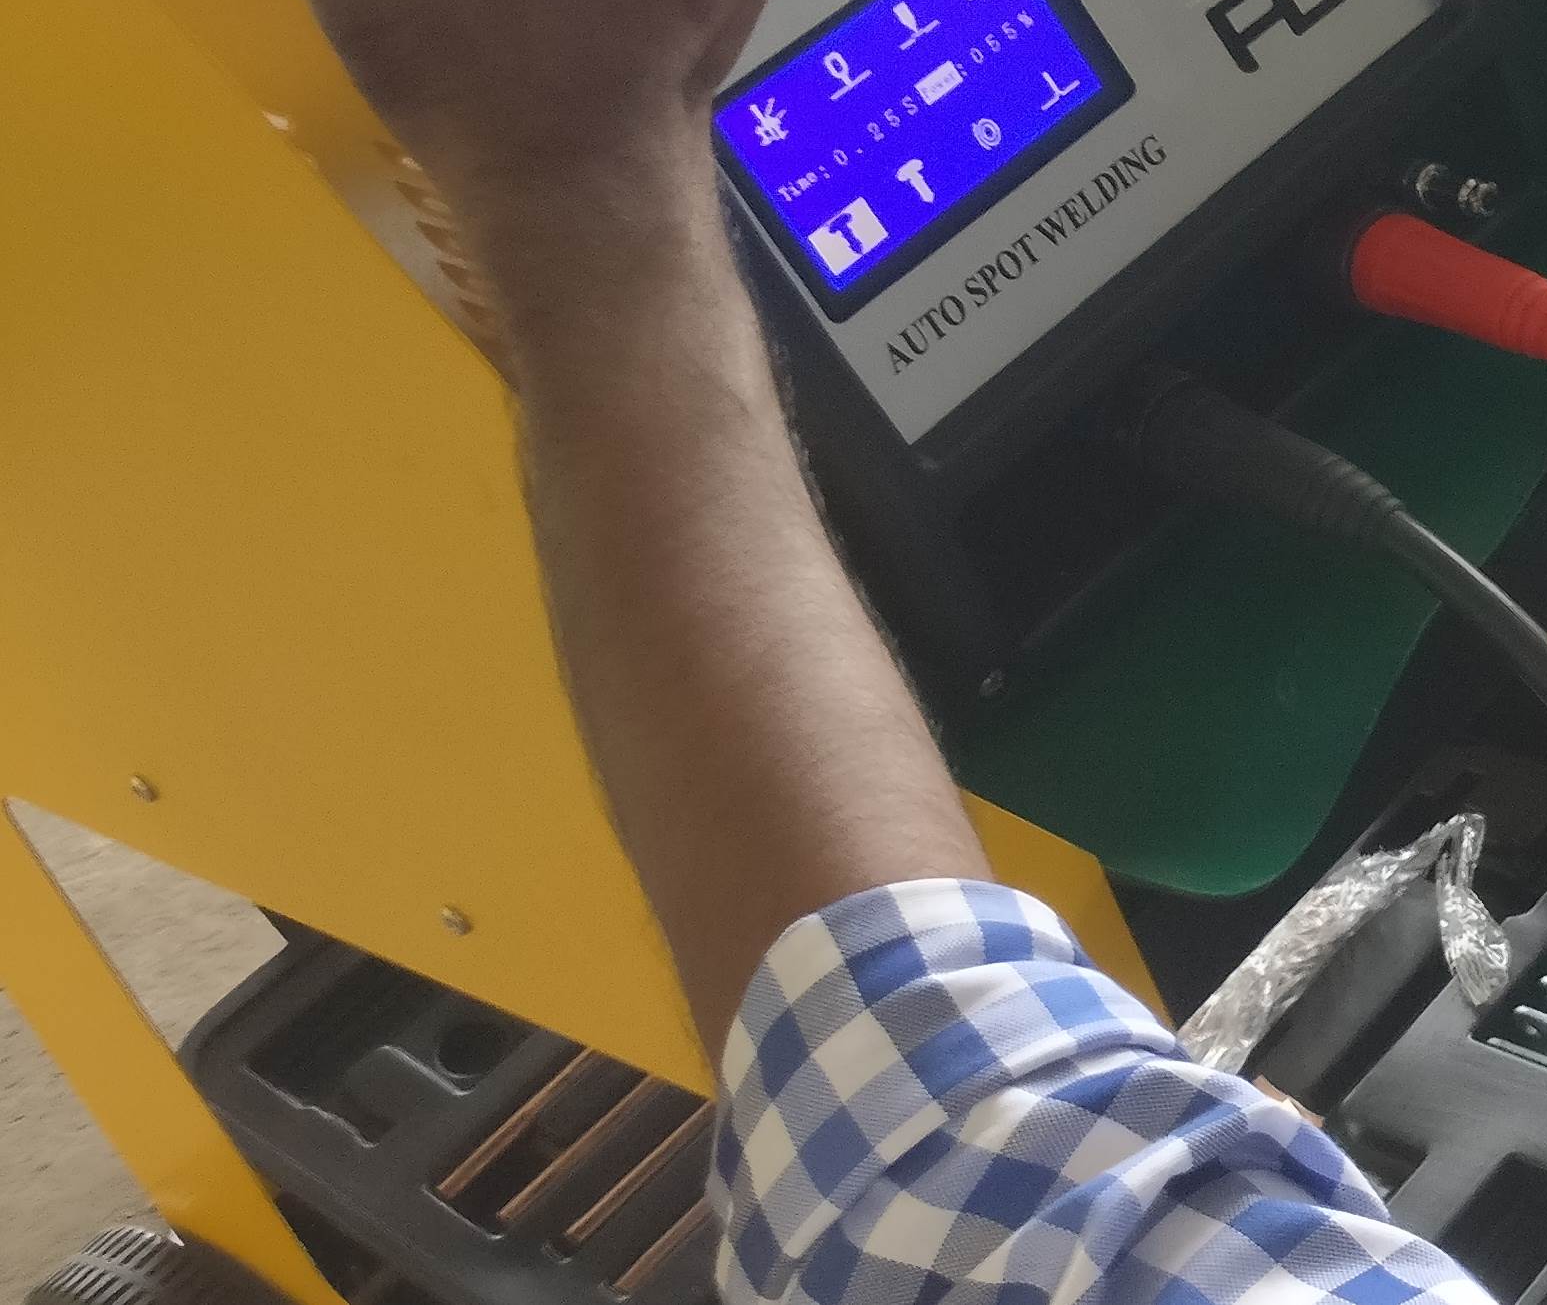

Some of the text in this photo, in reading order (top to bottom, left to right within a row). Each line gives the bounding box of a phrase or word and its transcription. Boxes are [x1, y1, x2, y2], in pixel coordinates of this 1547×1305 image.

[886, 134, 1169, 374] AUTO SPOT WELDING
